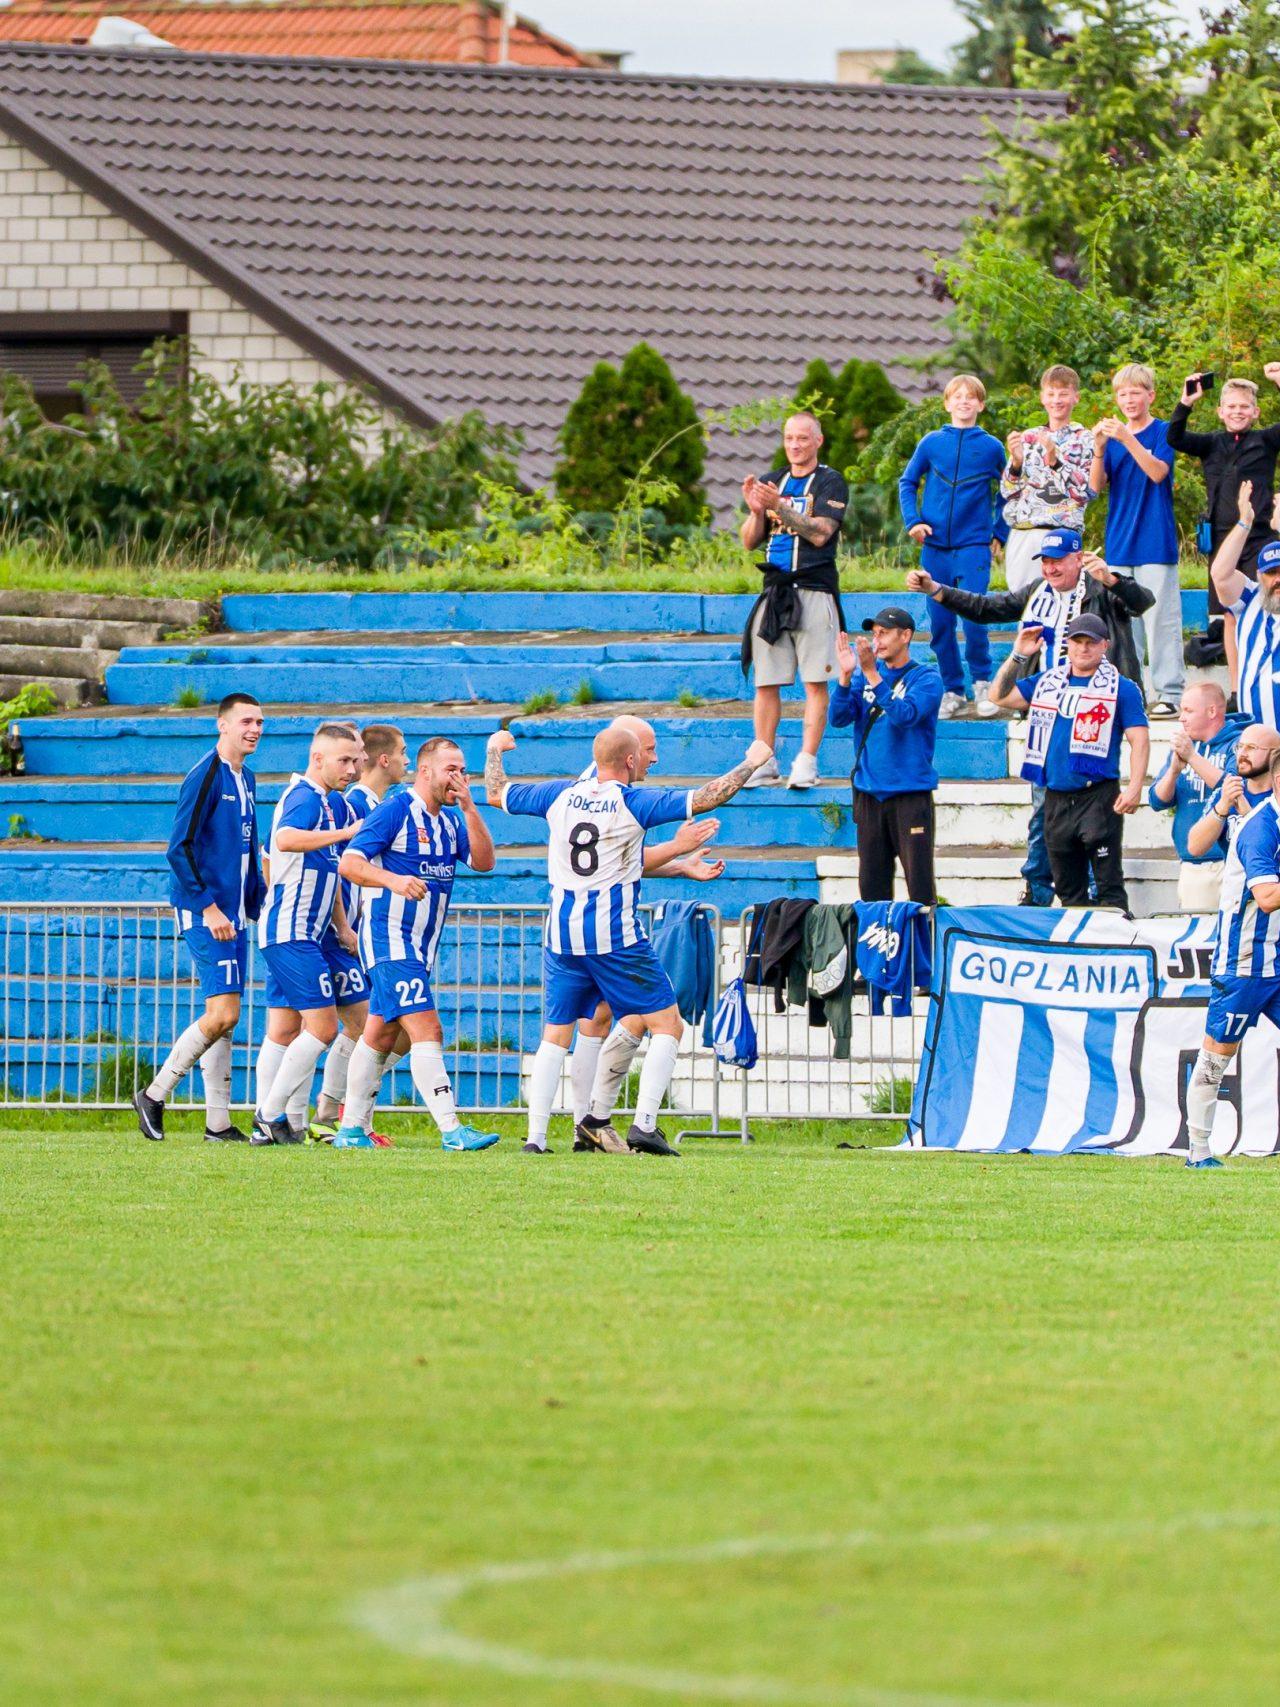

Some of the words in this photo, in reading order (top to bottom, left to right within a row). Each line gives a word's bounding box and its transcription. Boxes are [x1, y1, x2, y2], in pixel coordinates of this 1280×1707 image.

[569, 822, 600, 877] 8
[318, 972, 333, 998] 6
[335, 968, 365, 997] 29
[959, 952, 1141, 994] GOPLANIA
[395, 978, 428, 1007] 22
[1224, 1012, 1250, 1036] 17
